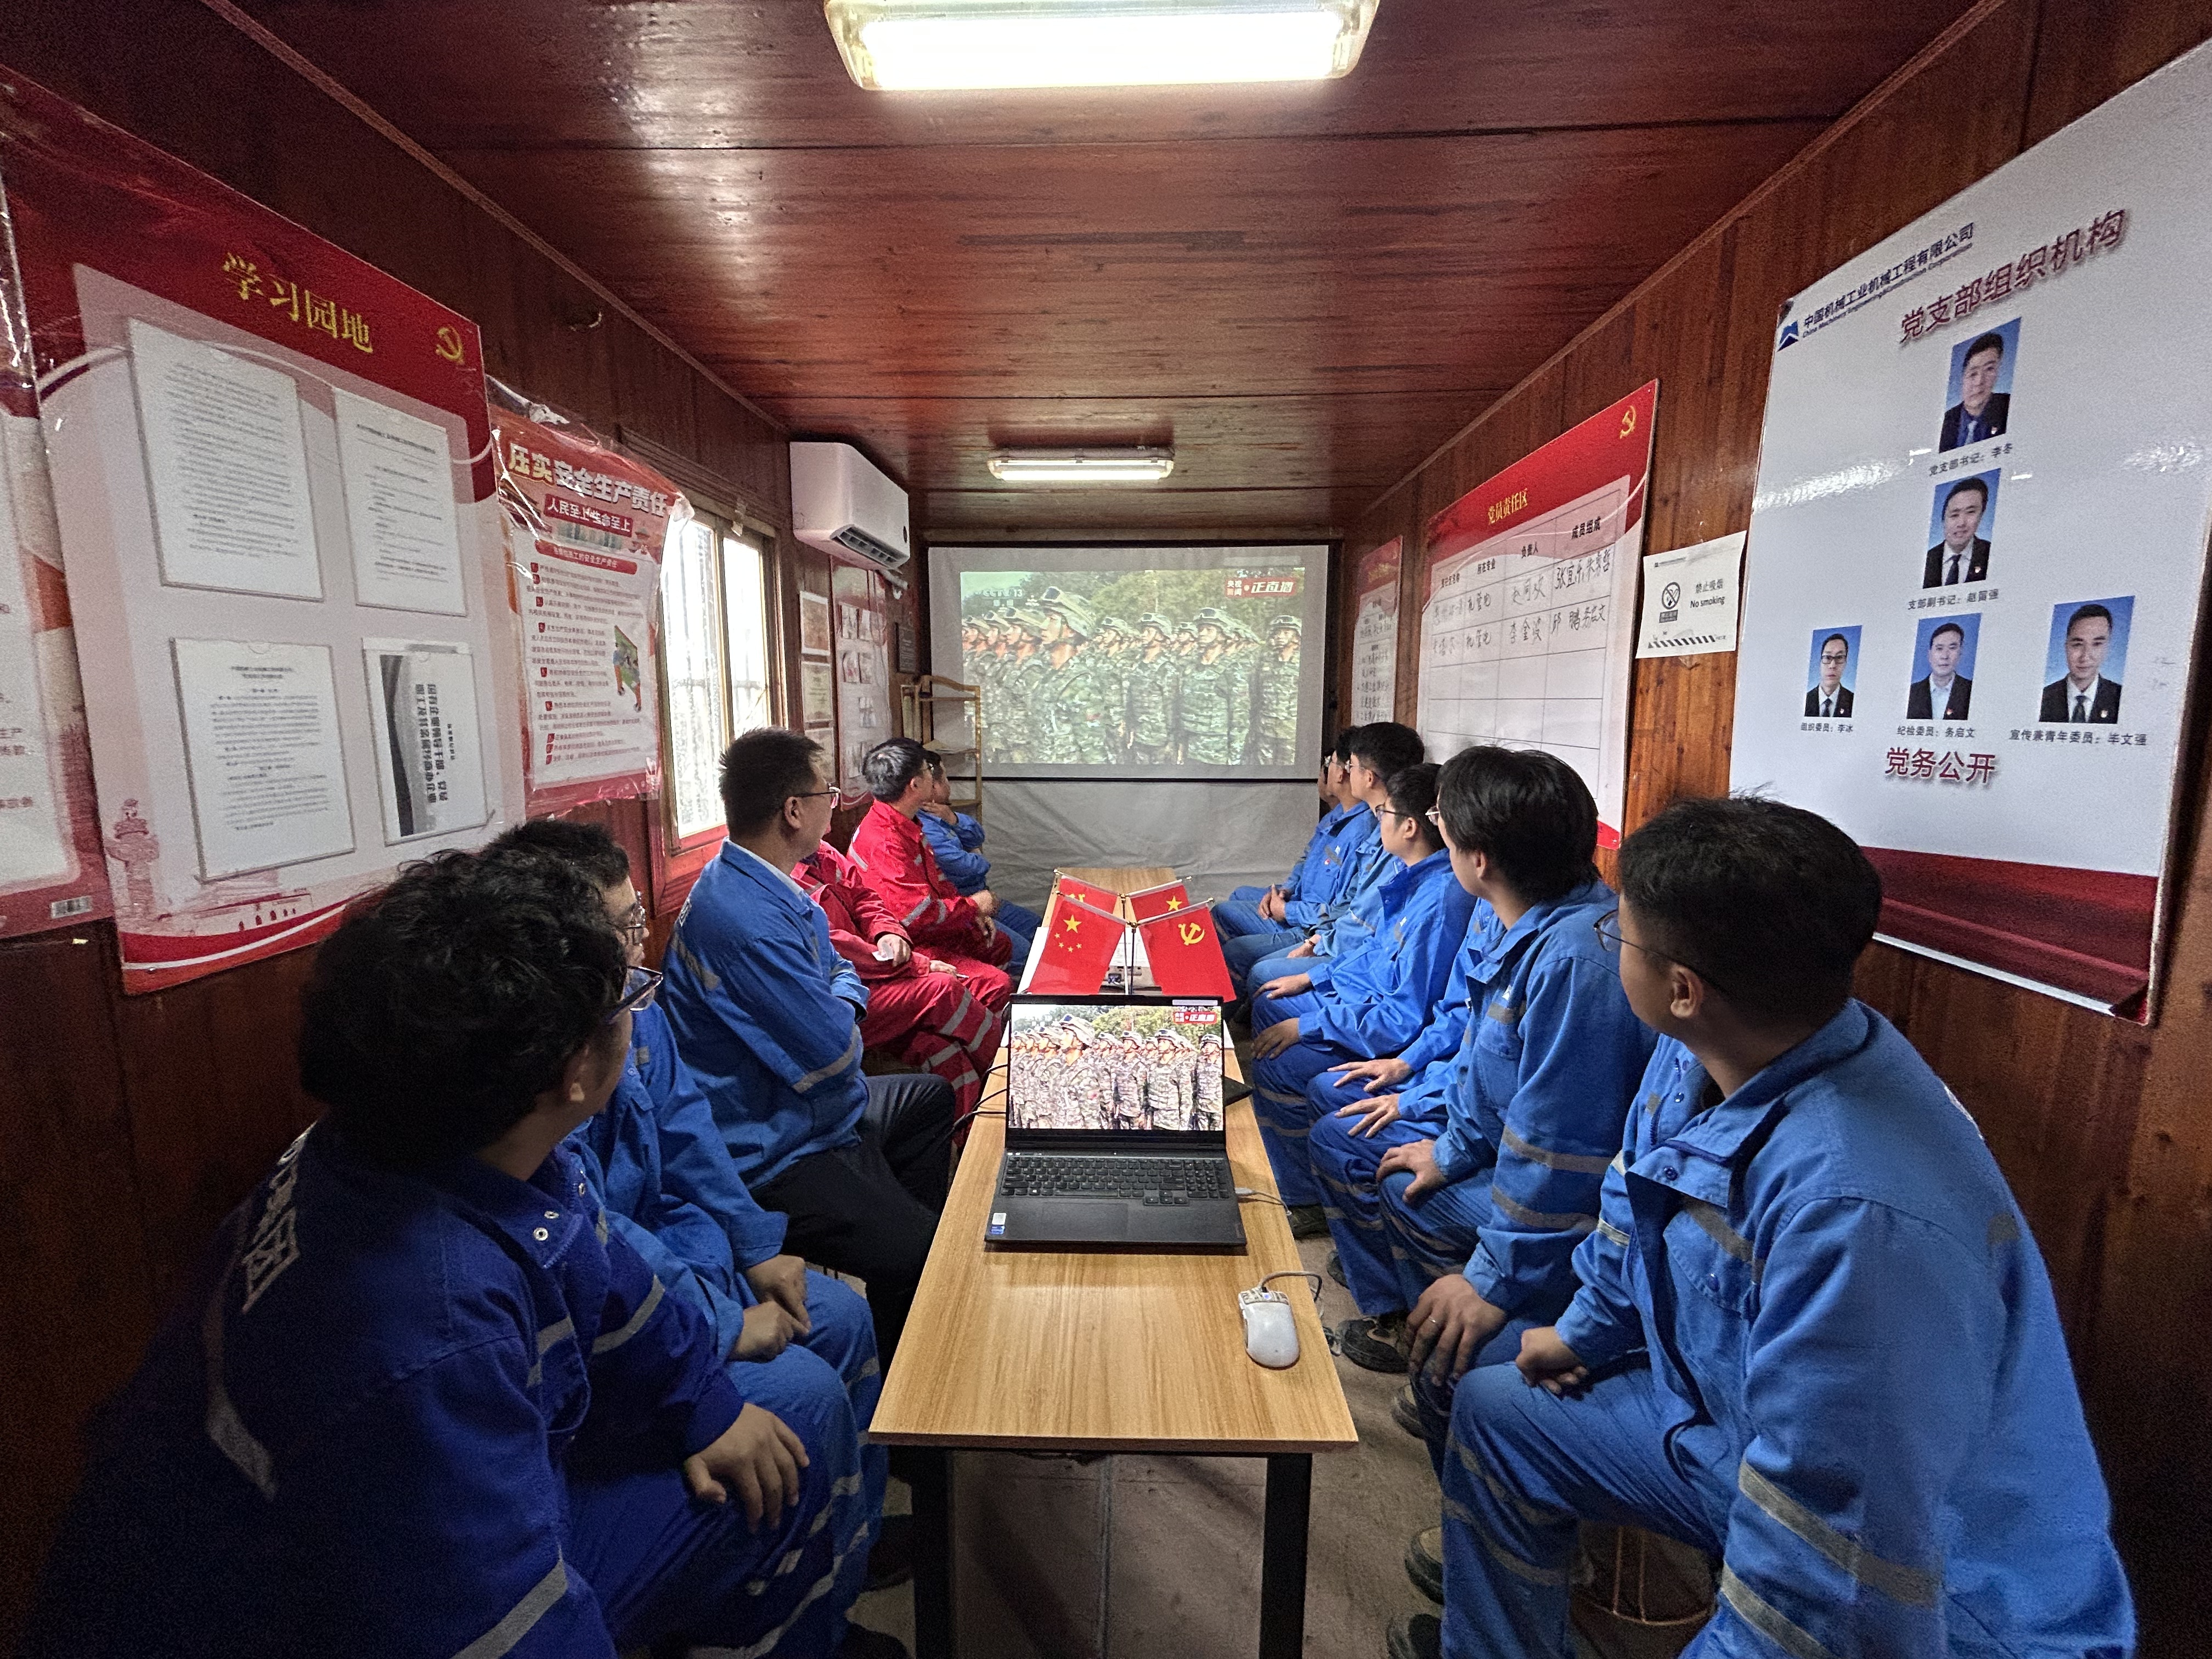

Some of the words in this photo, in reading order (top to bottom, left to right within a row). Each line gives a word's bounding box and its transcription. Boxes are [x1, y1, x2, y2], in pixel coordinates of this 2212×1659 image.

[1804, 222, 1974, 328] 中国机械工业机械工程有限公司
[1899, 208, 2126, 343] 党支部组织机构
[222, 252, 374, 354] 学习园地
[508, 442, 669, 517] 压实安全生产责任
[1488, 488, 1528, 524] 党员责任区
[1571, 516, 1601, 539] 成员组成
[1521, 542, 1539, 557] 负责人
[1013, 589, 1023, 597] 13
[1251, 581, 1294, 594] 正直播
[1696, 579, 1724, 594] 禁止吸烟
[1690, 600, 1700, 608] No
[1700, 596, 1725, 607] smoking
[1885, 747, 1996, 783] 党务公开
